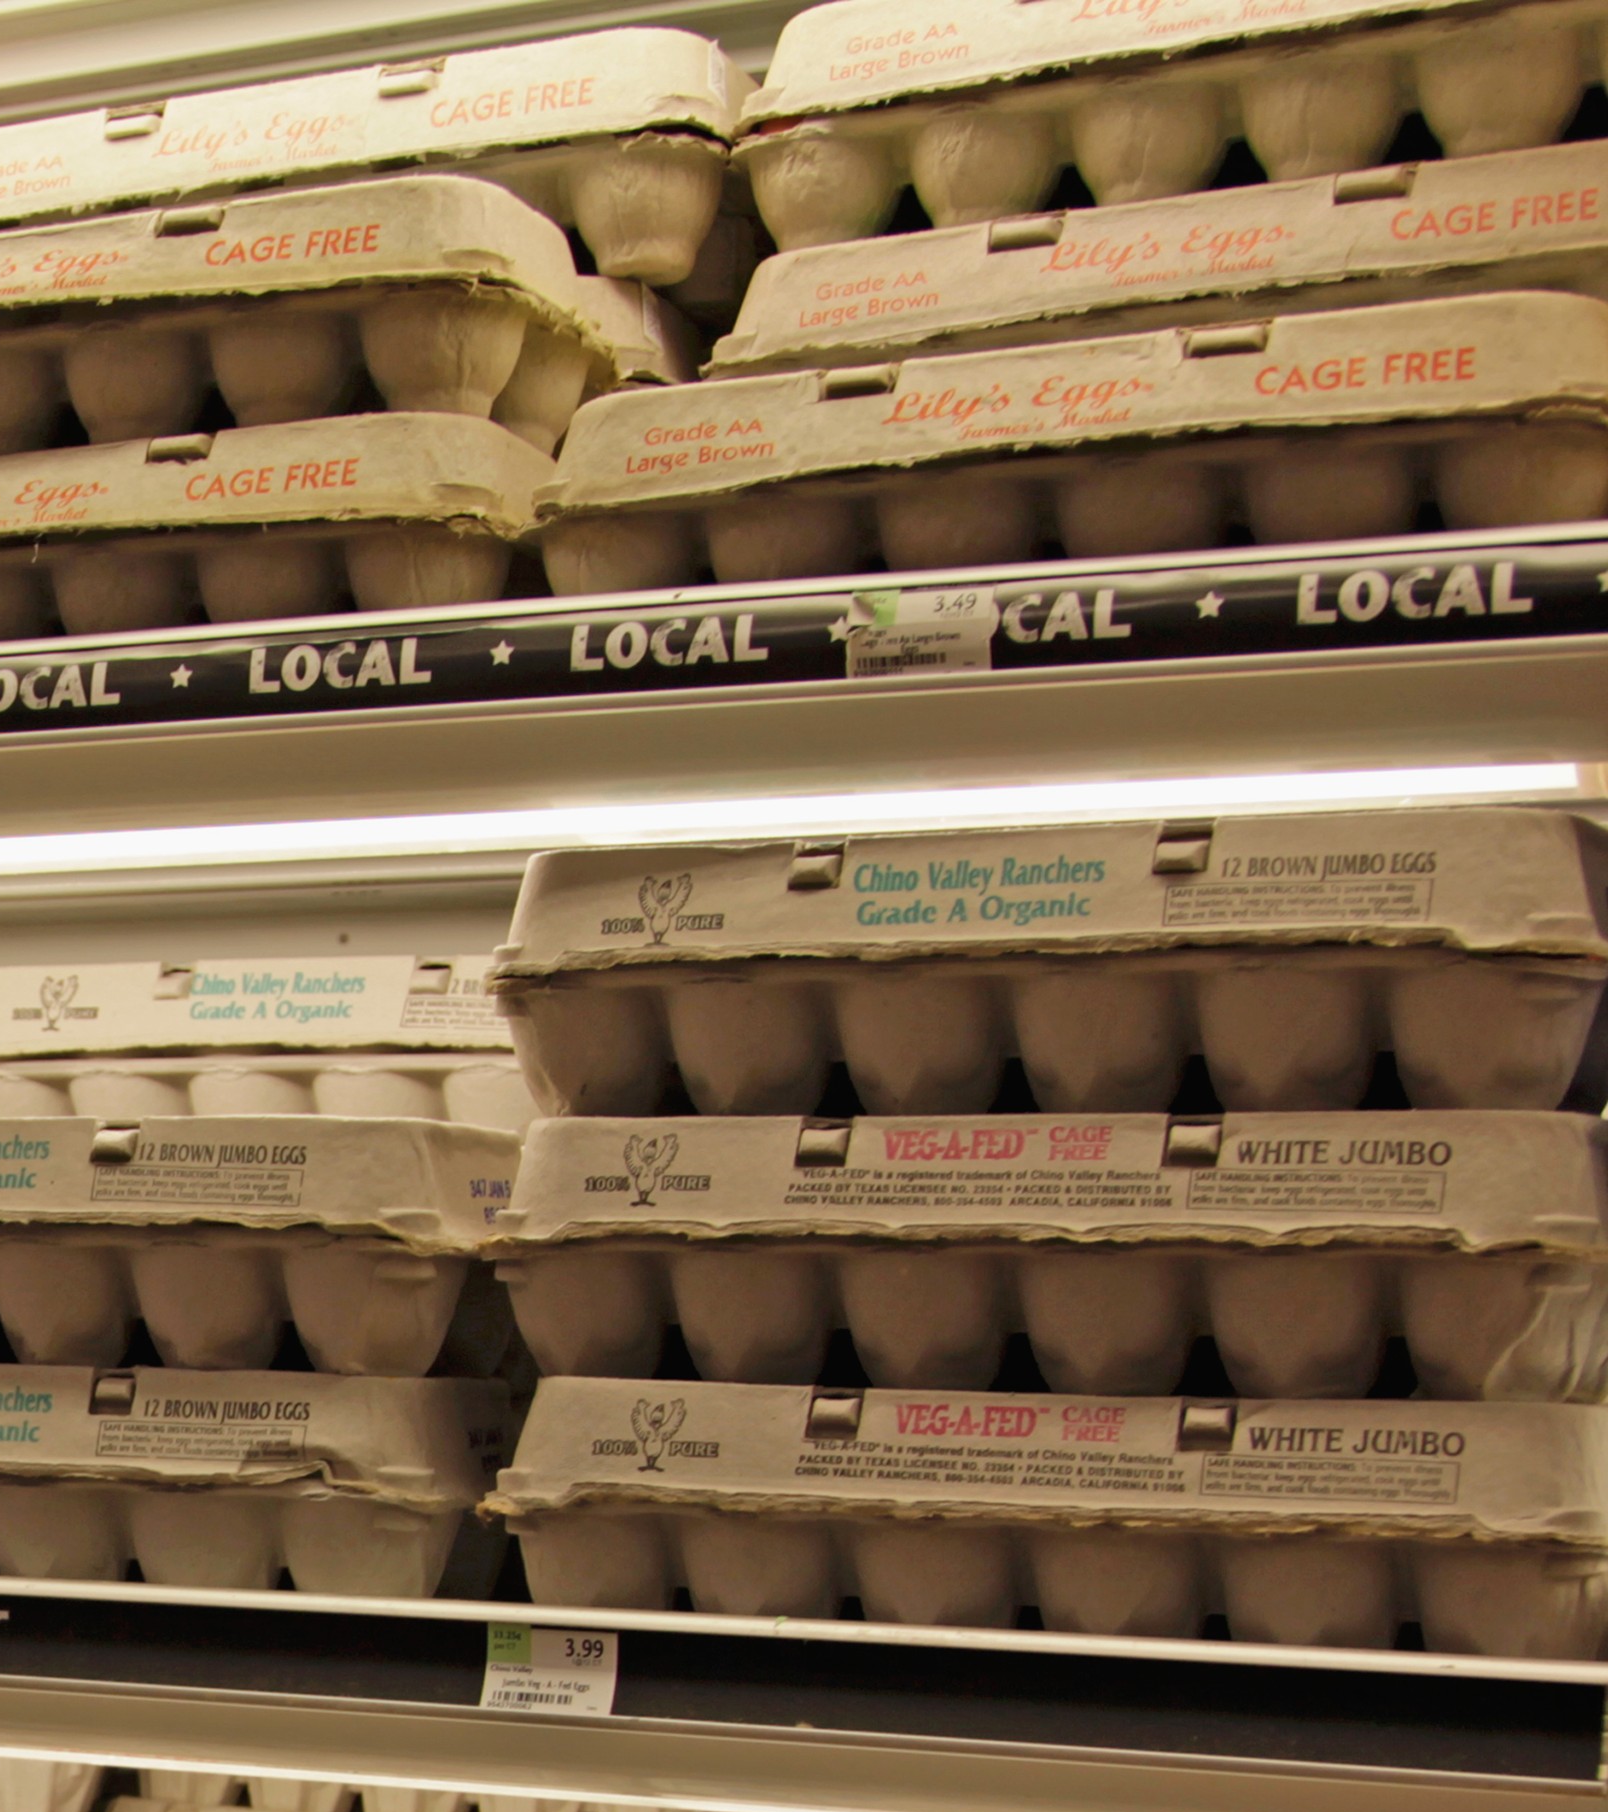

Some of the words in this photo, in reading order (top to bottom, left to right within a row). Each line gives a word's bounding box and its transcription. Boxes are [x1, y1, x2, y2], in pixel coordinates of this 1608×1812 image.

[1254, 357, 1366, 396] CAGE
[1384, 348, 1476, 385] FREE
[644, 424, 721, 446] Grade
[727, 418, 762, 437] AA
[625, 449, 693, 475] Large
[698, 438, 774, 464] Brown
[569, 615, 768, 672] LOCAL
[1295, 562, 1531, 626] LOCAL
[933, 593, 977, 613] 3.49
[249, 636, 431, 693] LOCAL
[853, 863, 921, 895] Chino
[927, 861, 995, 896] Valley
[1000, 856, 1106, 887] Ranchers
[1220, 857, 1240, 878] 12
[1245, 854, 1318, 878] BROWN
[1321, 853, 1385, 880] JUMBO
[1389, 852, 1437, 874] EGGS
[675, 913, 724, 931] PURE
[855, 897, 942, 927] Grade
[948, 897, 967, 922] A
[980, 891, 1091, 927] Organic
[882, 1129, 1025, 1162] VEG-A-FED
[1049, 1125, 1113, 1142] CAGE
[1047, 1142, 1108, 1160] FREE
[1236, 1139, 1328, 1166] WHITE
[1339, 1139, 1452, 1166] JUMBO
[565, 1638, 604, 1658] 3.99
